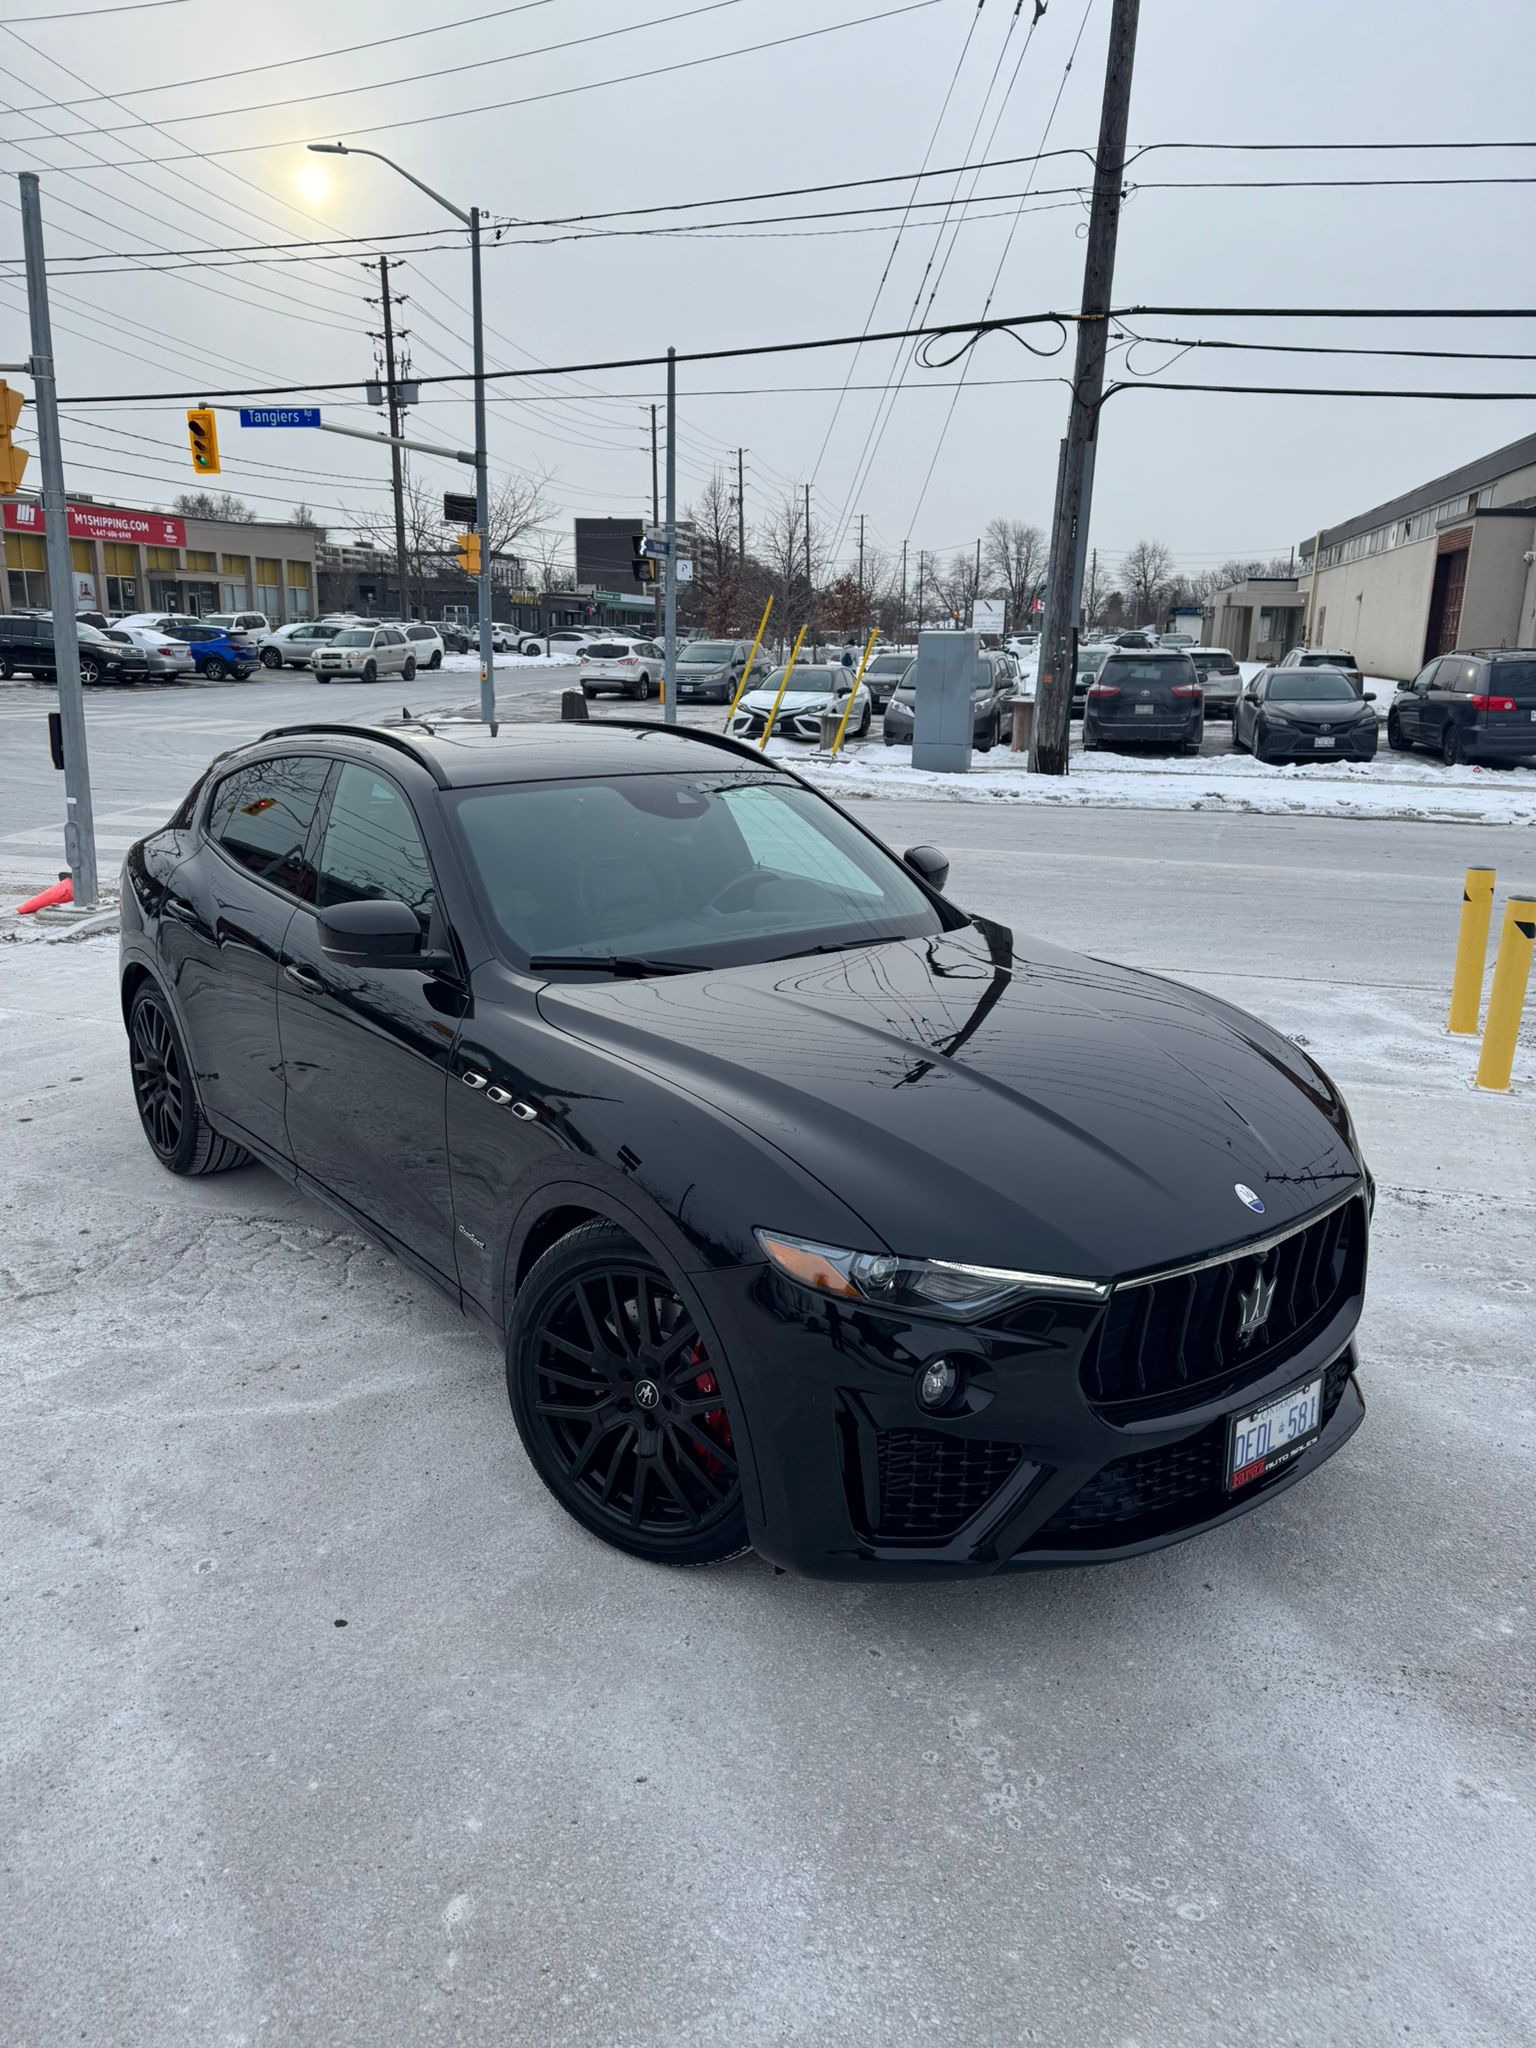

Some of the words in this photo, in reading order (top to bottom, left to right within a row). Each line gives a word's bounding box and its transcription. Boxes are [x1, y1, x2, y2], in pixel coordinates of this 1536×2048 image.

[248, 409, 300, 426] Tangiers
[74, 513, 150, 532] M1SHIPPING.COM
[1261, 1396, 1298, 1421] ONTARIO
[1234, 1419, 1276, 1469] DEDL
[1287, 1395, 1316, 1440] 581
[1265, 1453, 1289, 1471] AUTO
[1290, 1436, 1318, 1457] SALES
